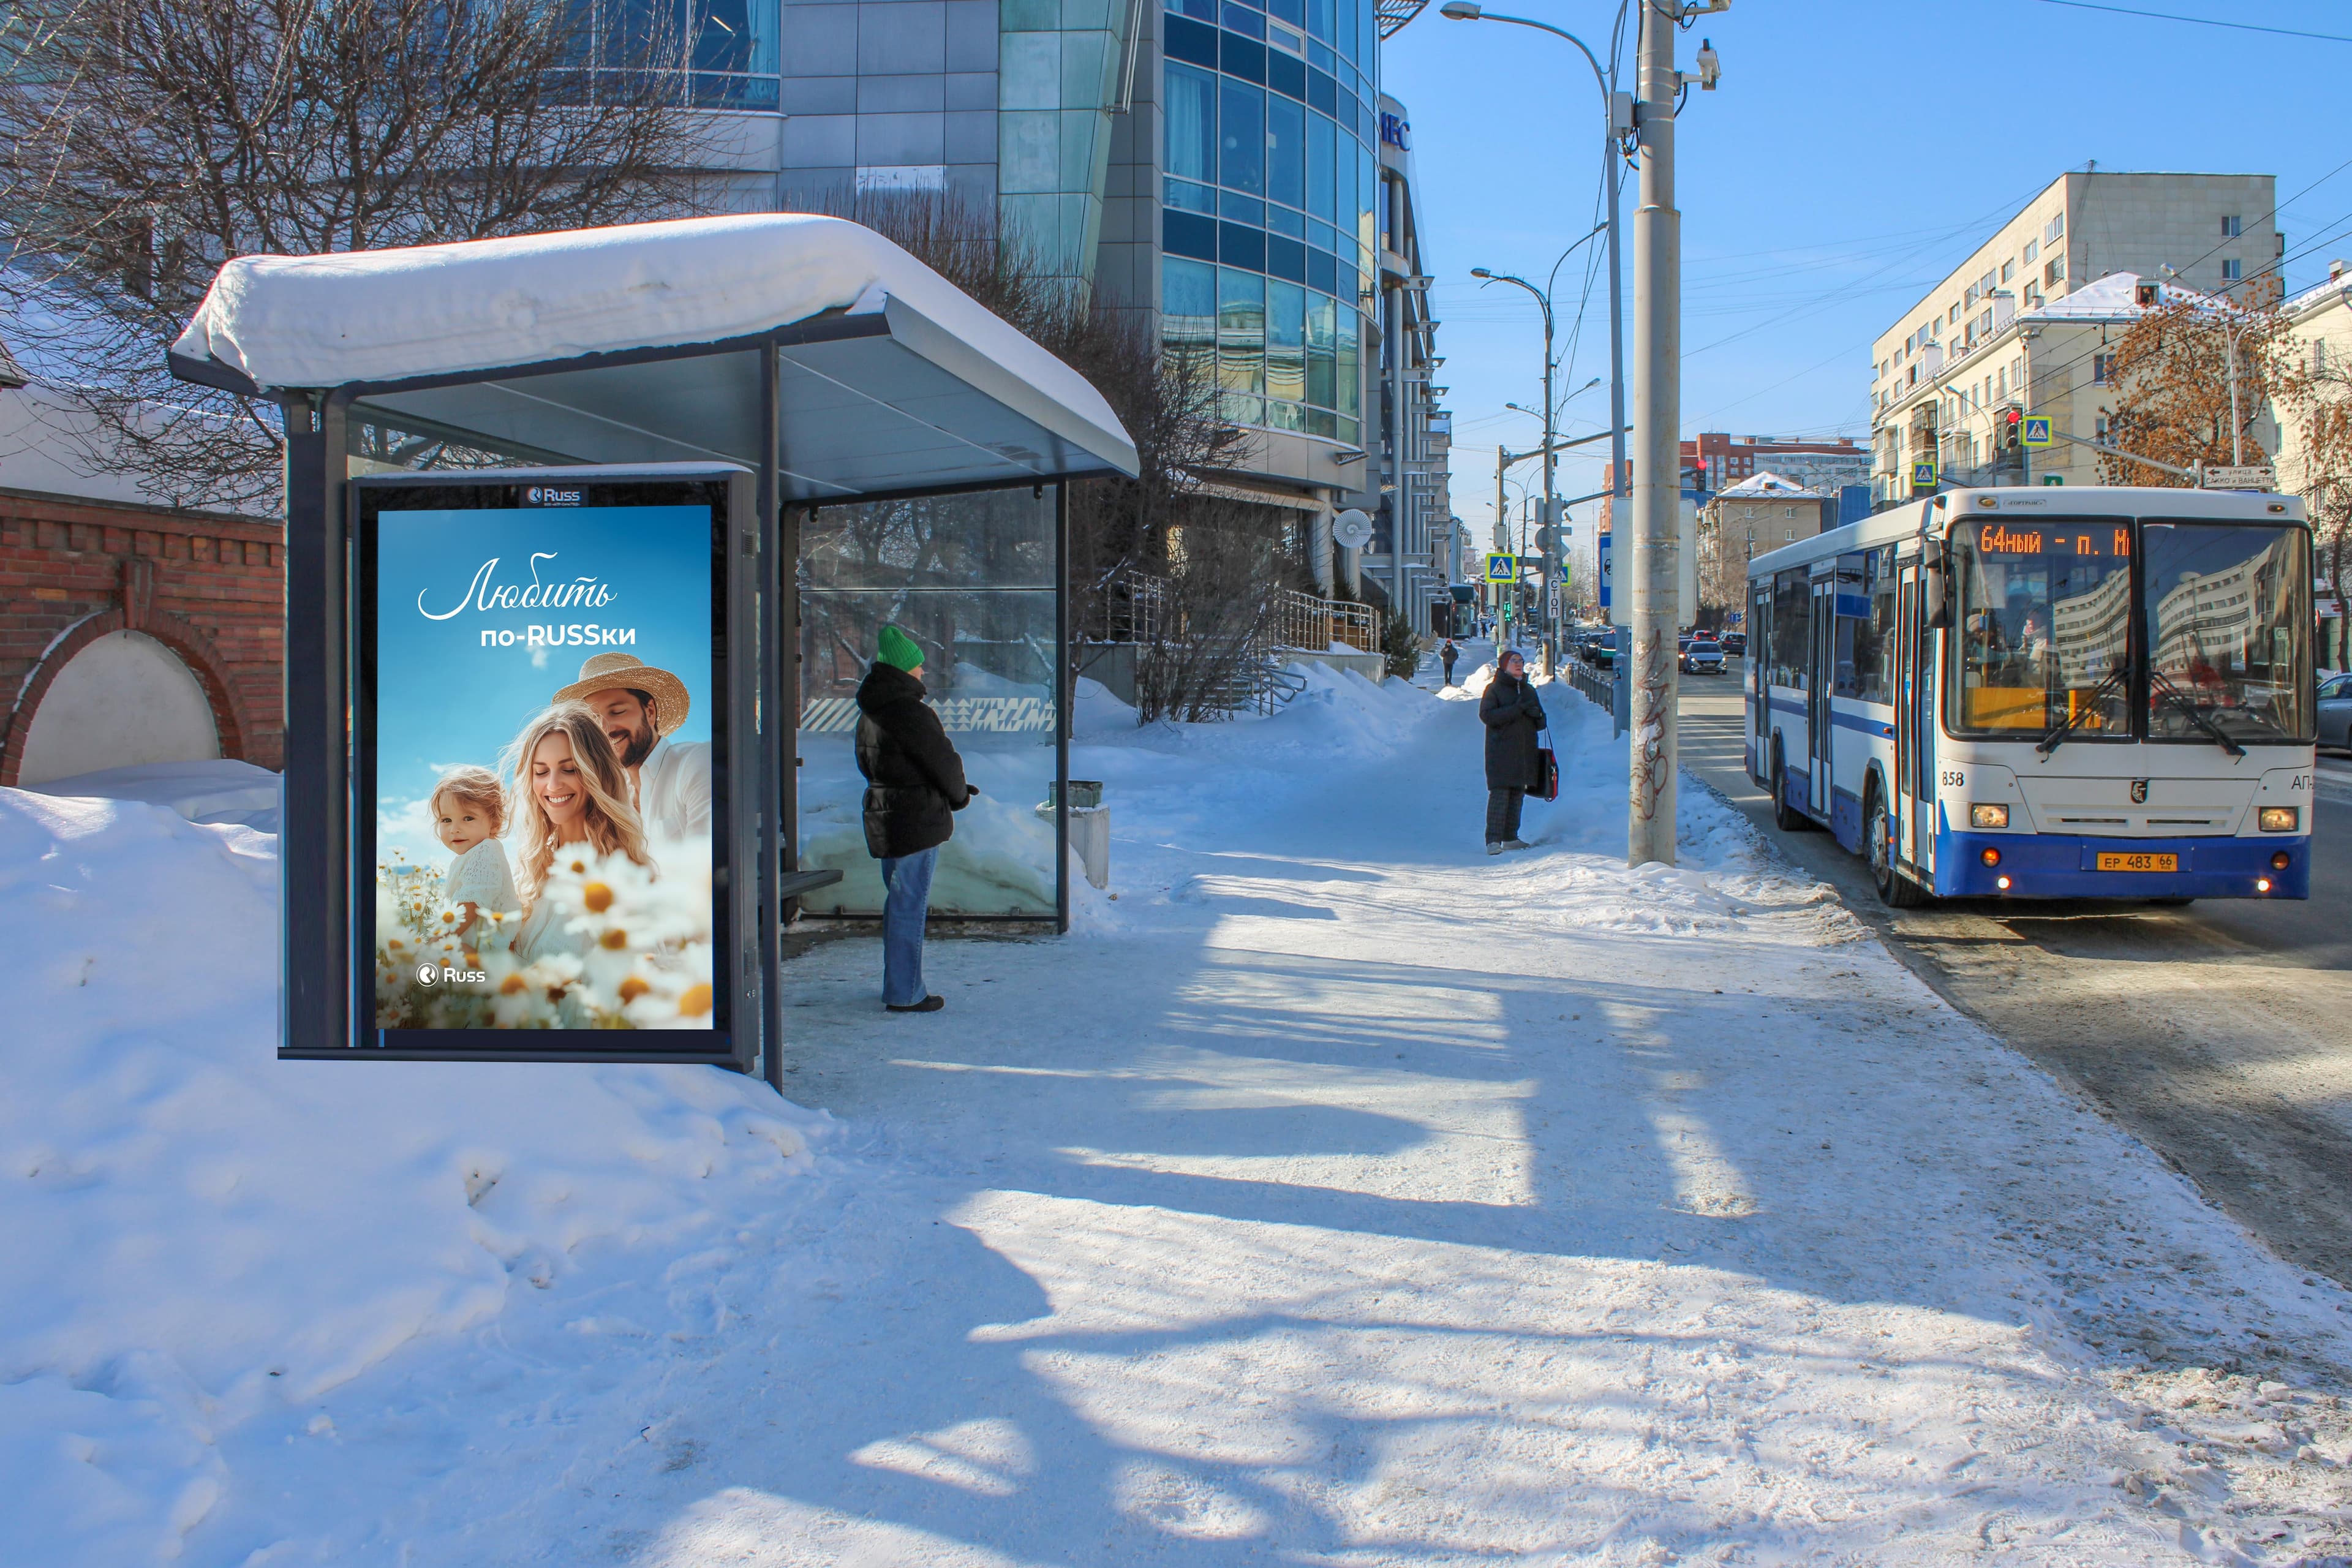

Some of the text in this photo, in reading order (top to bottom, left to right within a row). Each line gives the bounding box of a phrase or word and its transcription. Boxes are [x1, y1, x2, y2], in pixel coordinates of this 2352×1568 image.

[544, 489, 580, 502] Russ
[1981, 525, 2041, 553] 64ный
[2077, 535, 2100, 555] п.
[418, 552, 618, 620] Любить
[481, 624, 636, 647] по-RUSSки
[1942, 771, 1964, 786] 858
[2105, 856, 2172, 869] ЕР 483 66
[444, 967, 486, 982] Russ
